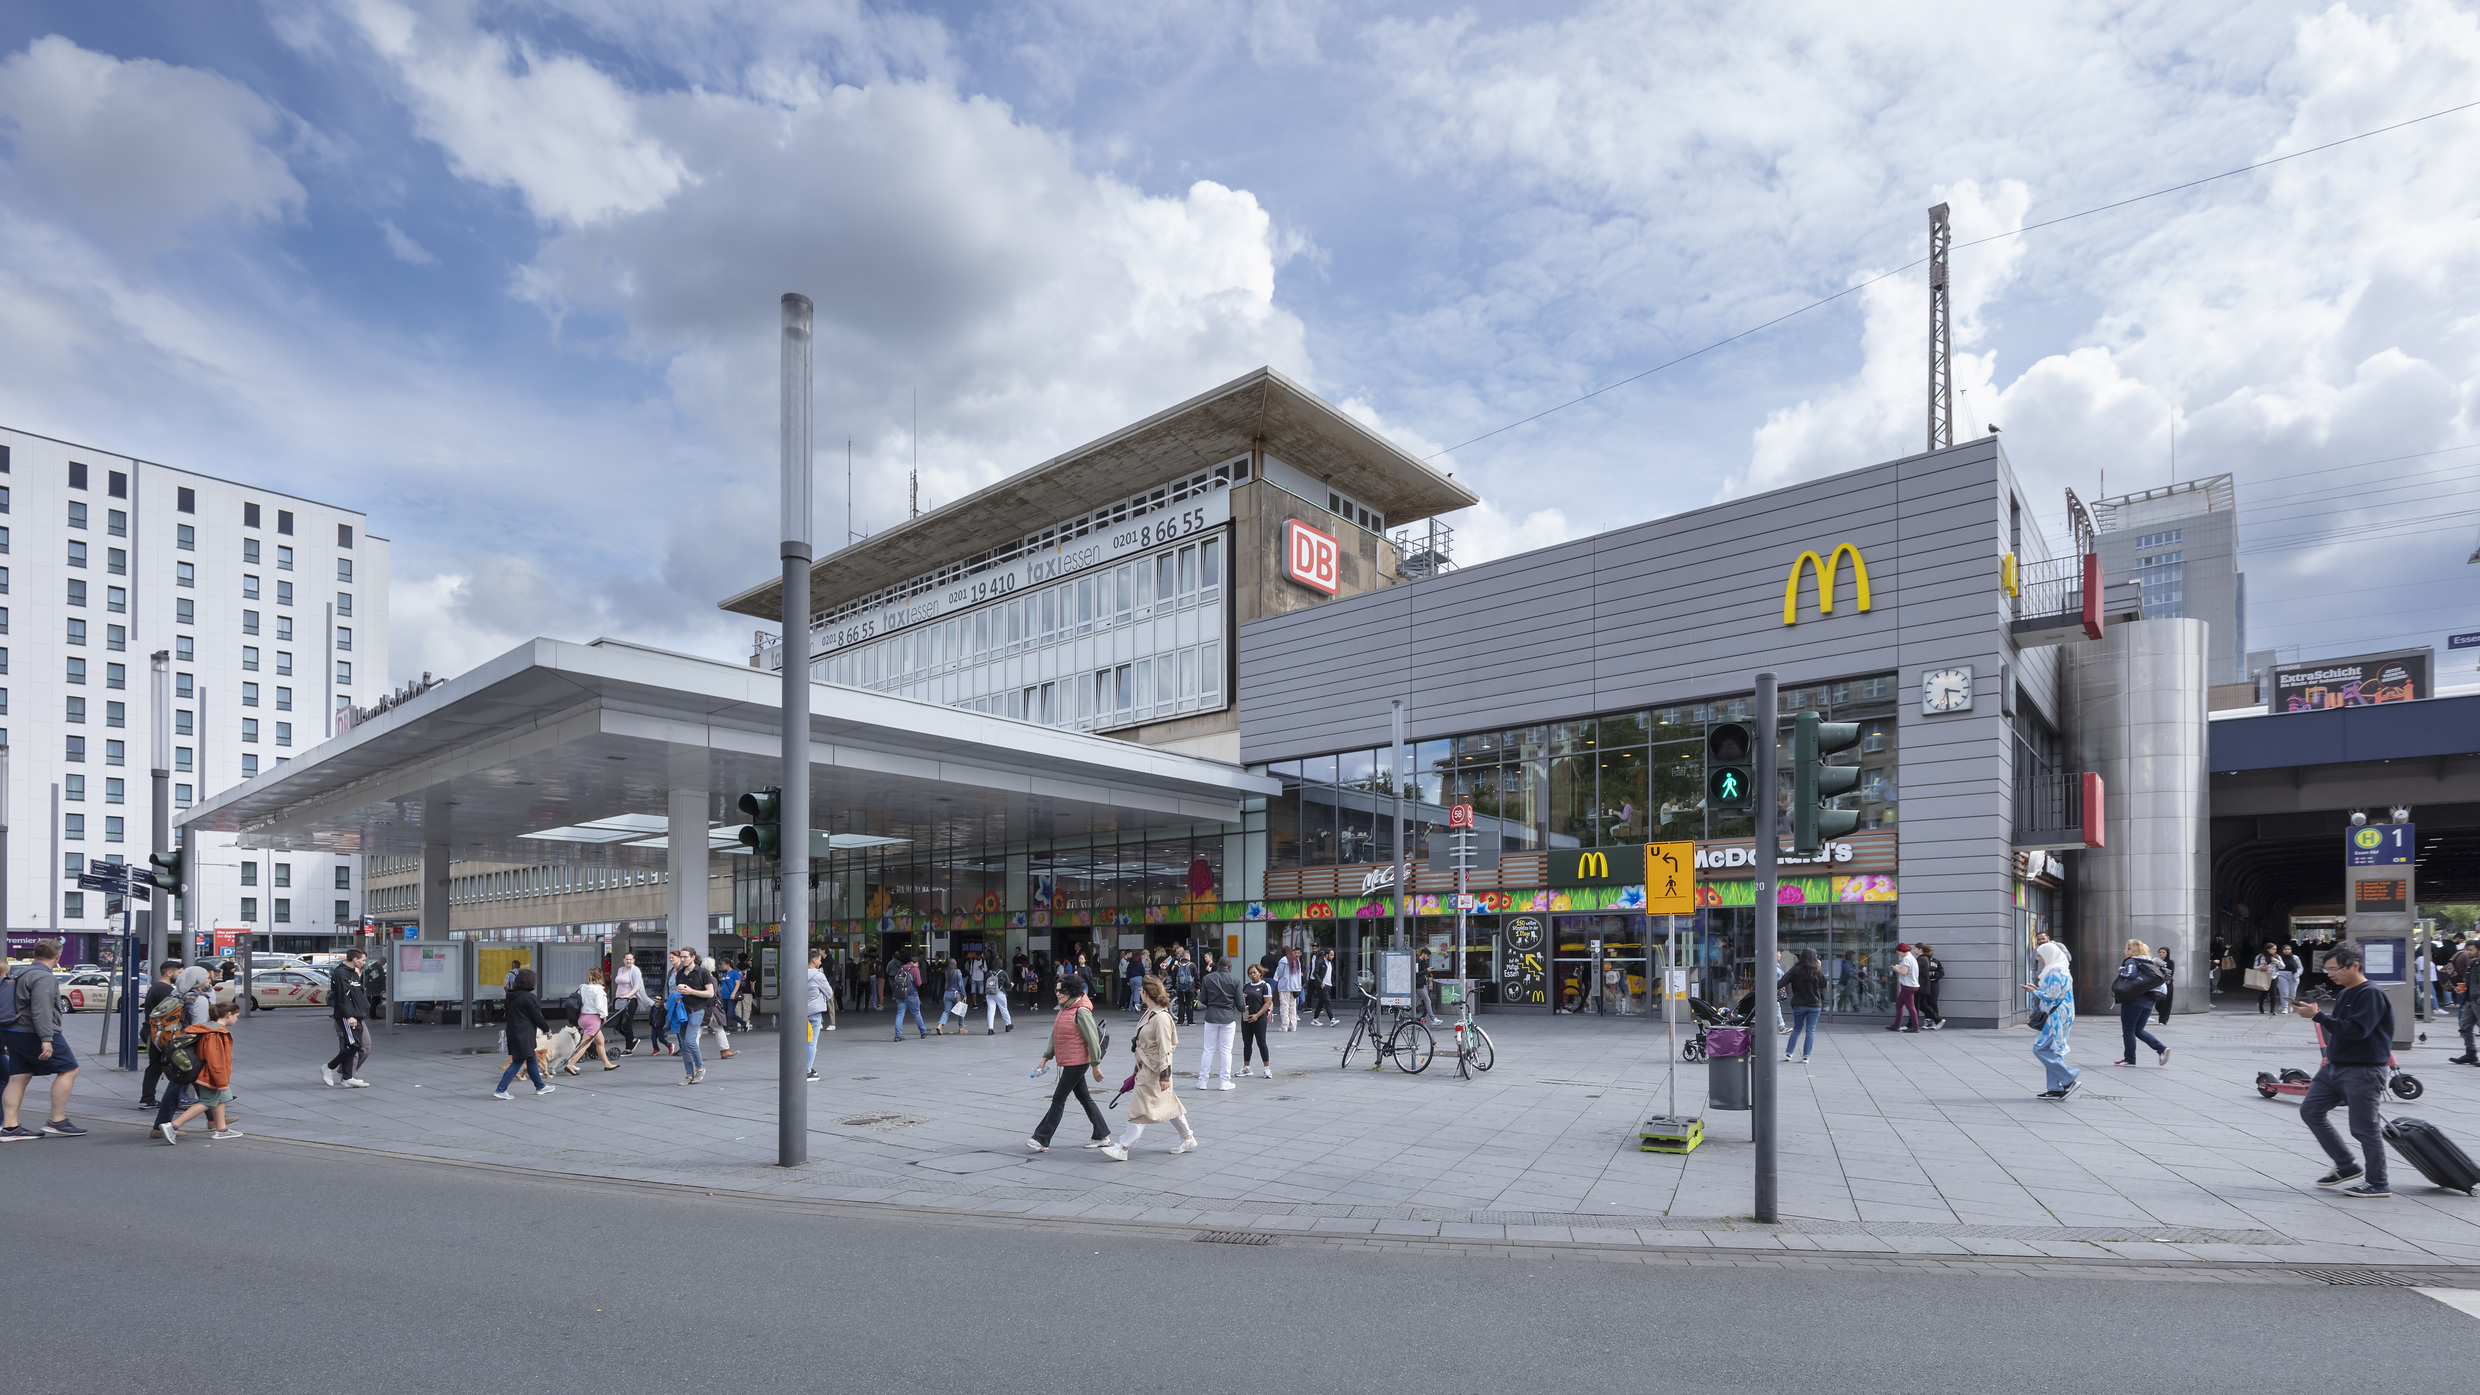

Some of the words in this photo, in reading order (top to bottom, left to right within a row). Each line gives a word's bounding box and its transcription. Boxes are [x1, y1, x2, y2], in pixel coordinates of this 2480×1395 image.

[1113, 530, 1138, 549] 0201
[1140, 526, 1151, 547] 8
[1156, 517, 1177, 542] 66
[1183, 507, 1204, 533] 55
[1296, 531, 1333, 582] DB
[949, 589, 967, 604] 0201
[971, 582, 987, 603] 19
[990, 572, 1015, 596] 410
[822, 633, 836, 646] 0201
[838, 631, 844, 646] 8
[846, 626, 859, 643] 66
[862, 620, 875, 637] 55
[2280, 667, 2362, 684] ExtraSchicht
[1455, 810, 1462, 818] 58
[2392, 828, 2402, 847] 1
[1651, 847, 1660, 856] U
